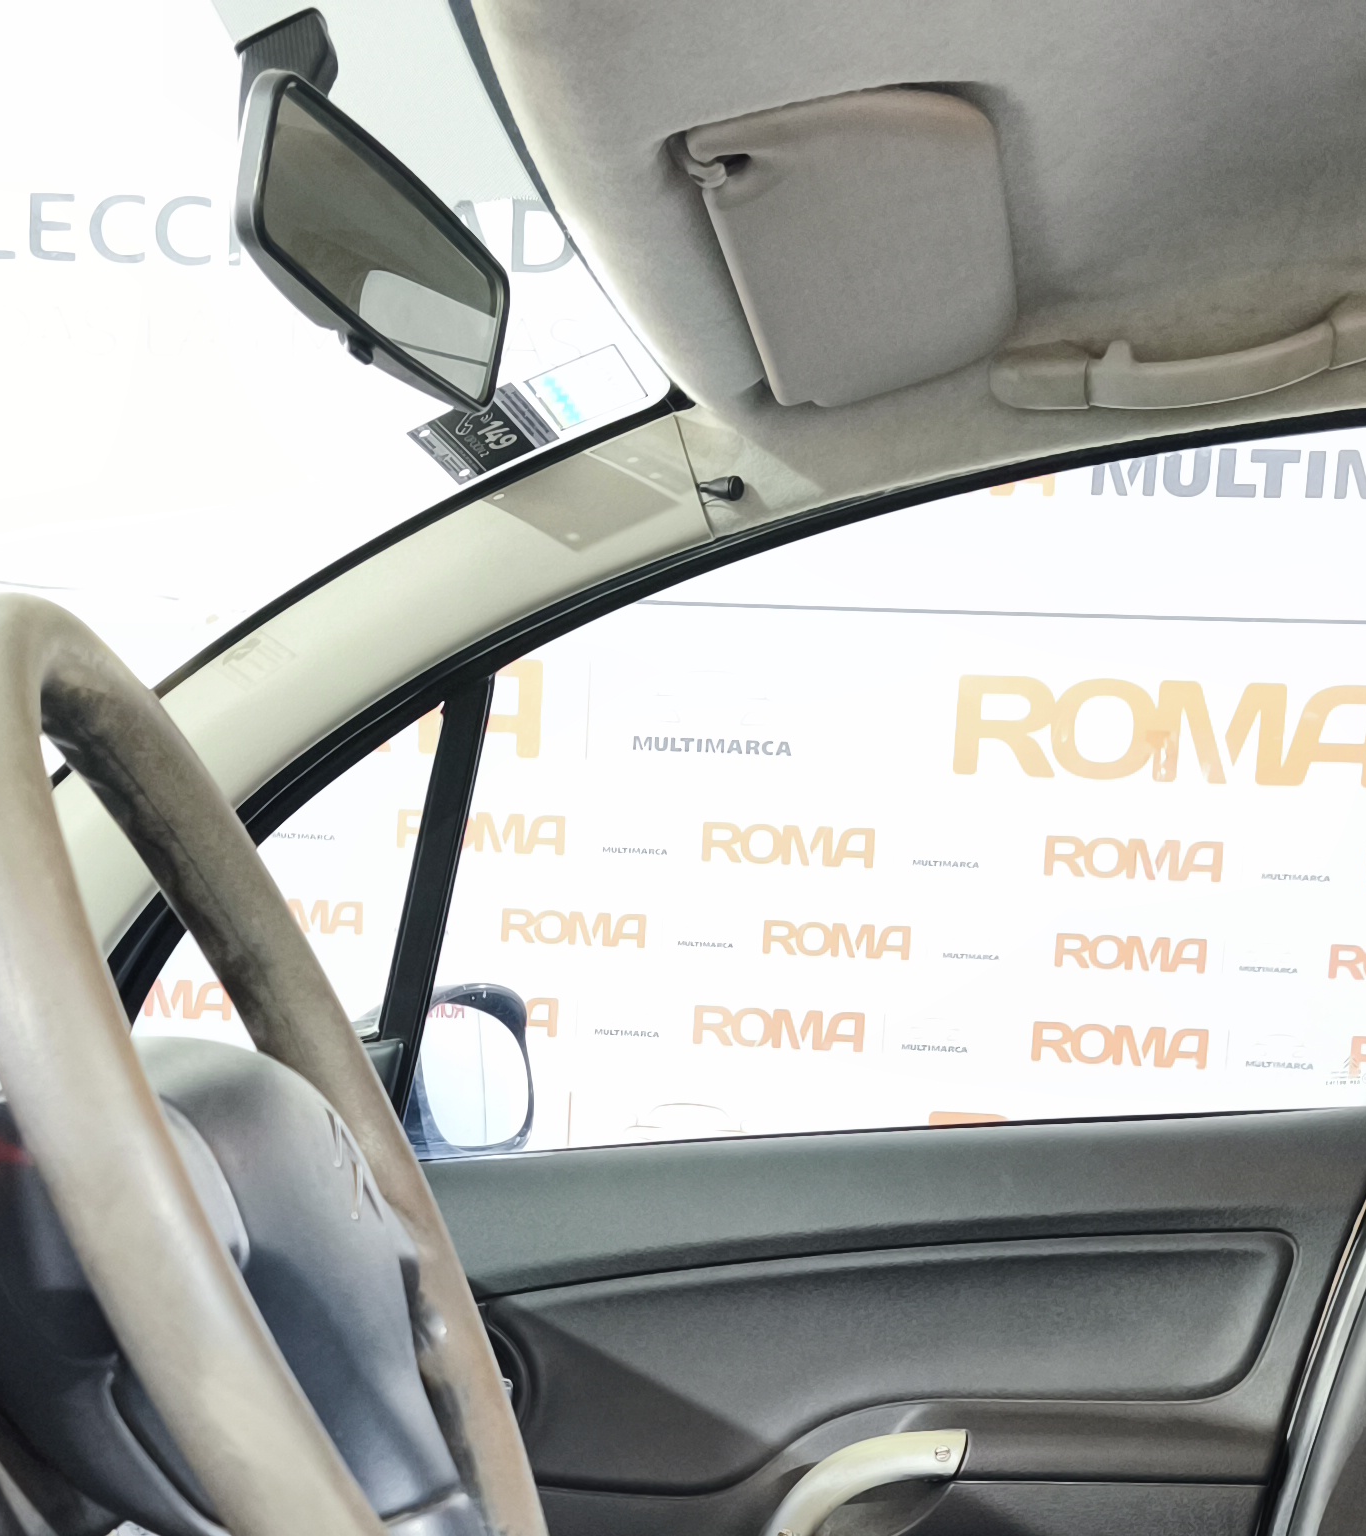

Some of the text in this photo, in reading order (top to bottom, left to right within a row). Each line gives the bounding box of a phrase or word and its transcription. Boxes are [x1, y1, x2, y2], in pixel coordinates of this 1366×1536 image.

[477, 420, 518, 450] 149
[632, 735, 792, 757] MULTIMARCA
[602, 846, 668, 856] MULTIMARCA
[701, 821, 980, 870] ROMA MULTIMARCA
[1043, 835, 1331, 883] ROMA MULTIMARCA
[500, 908, 734, 949] ROMA MULTIMARCA
[762, 919, 1000, 961] ROMA MULTIMARCA
[1054, 933, 1299, 975] ROMA MULTIMARCA
[593, 1028, 660, 1038] MULTIMARCA
[692, 1006, 968, 1054] ROMA MULTIMARCA
[1030, 1021, 1314, 1071] ROMA MULTIMARCA
